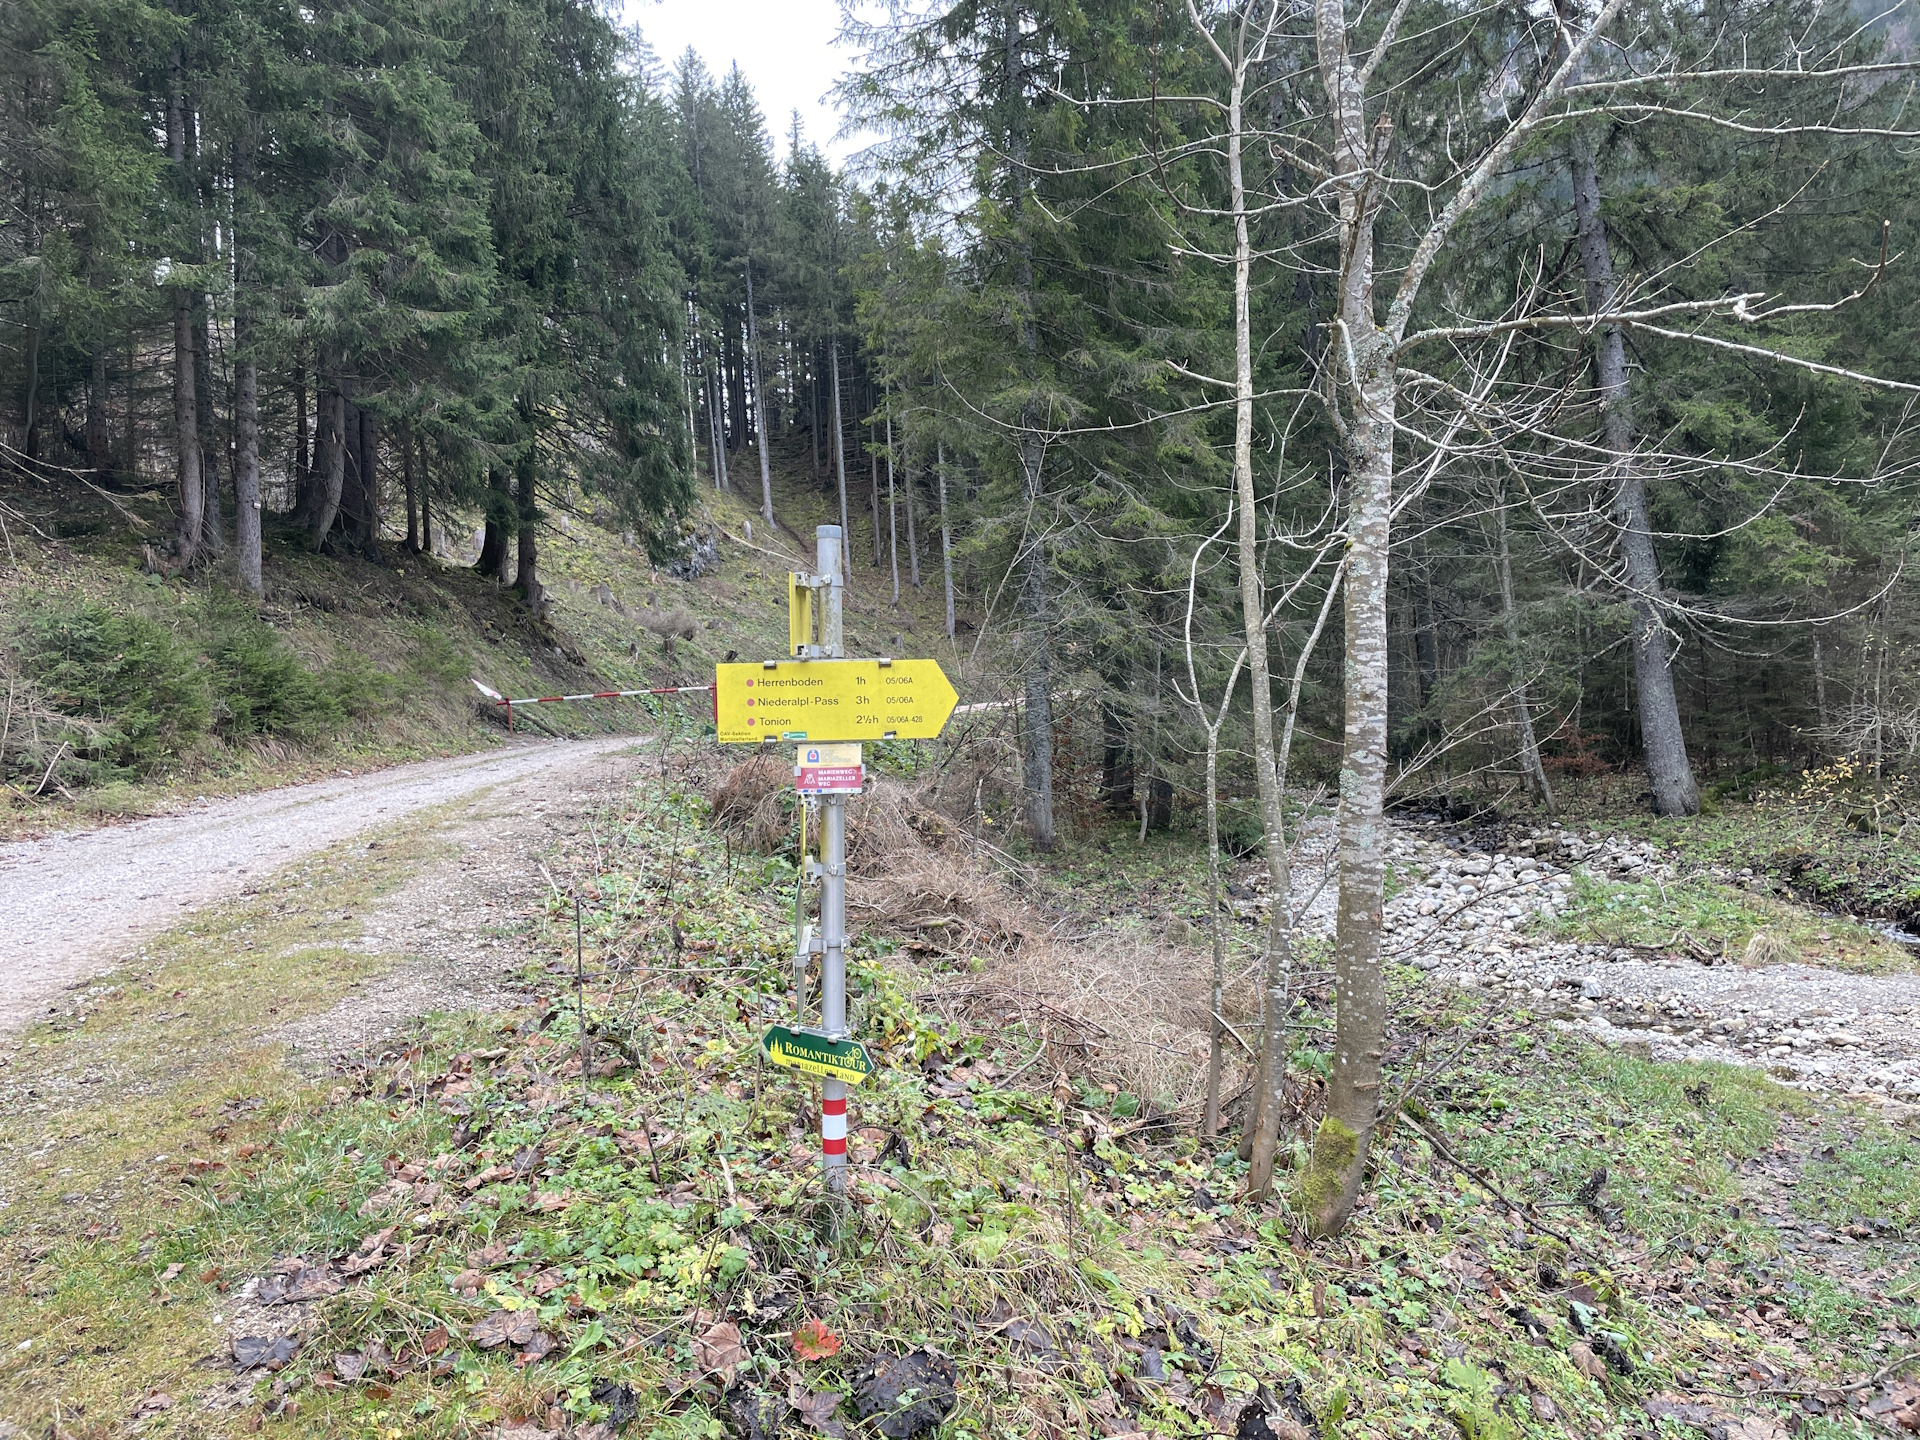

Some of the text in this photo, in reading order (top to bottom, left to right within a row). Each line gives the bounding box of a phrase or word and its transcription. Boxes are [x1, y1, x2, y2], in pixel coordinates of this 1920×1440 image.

[757, 676, 914, 688] Herrenboden 1h 05/06A
[758, 695, 914, 707] Niederalpl-Pass 3h 05/06A
[759, 717, 791, 726] Tonion
[886, 715, 923, 724] 05/06A-428
[785, 1042, 866, 1071] ROMANTIKTOUR
